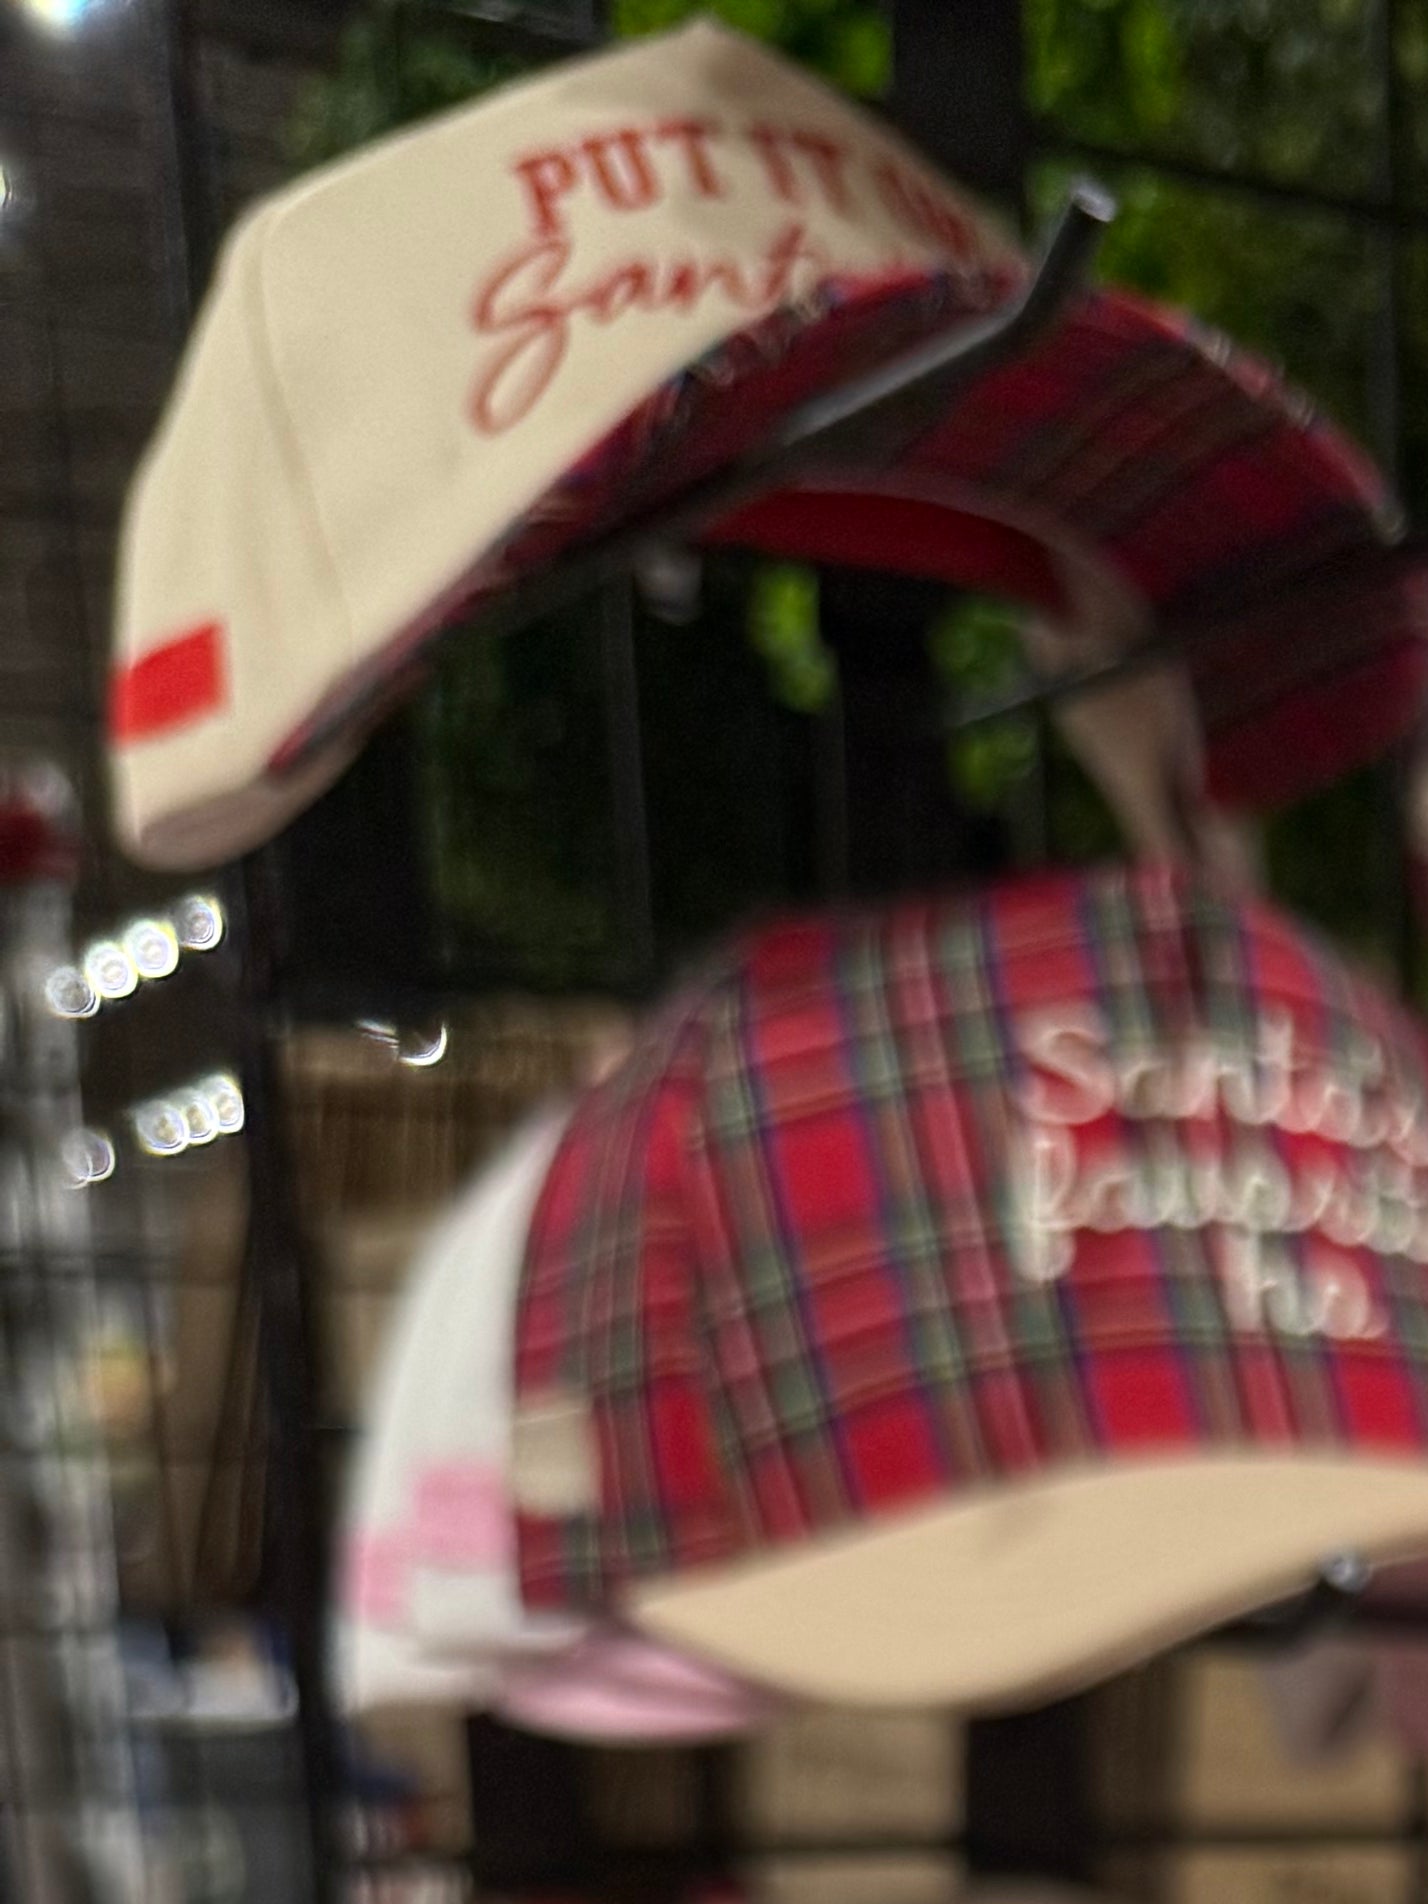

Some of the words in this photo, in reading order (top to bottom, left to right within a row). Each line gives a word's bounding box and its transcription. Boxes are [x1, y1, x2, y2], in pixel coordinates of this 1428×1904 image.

[514, 114, 724, 240] PUT
[750, 122, 860, 218] IT
[468, 222, 832, 438] Sant
[1220, 1218, 1390, 1342] ho
